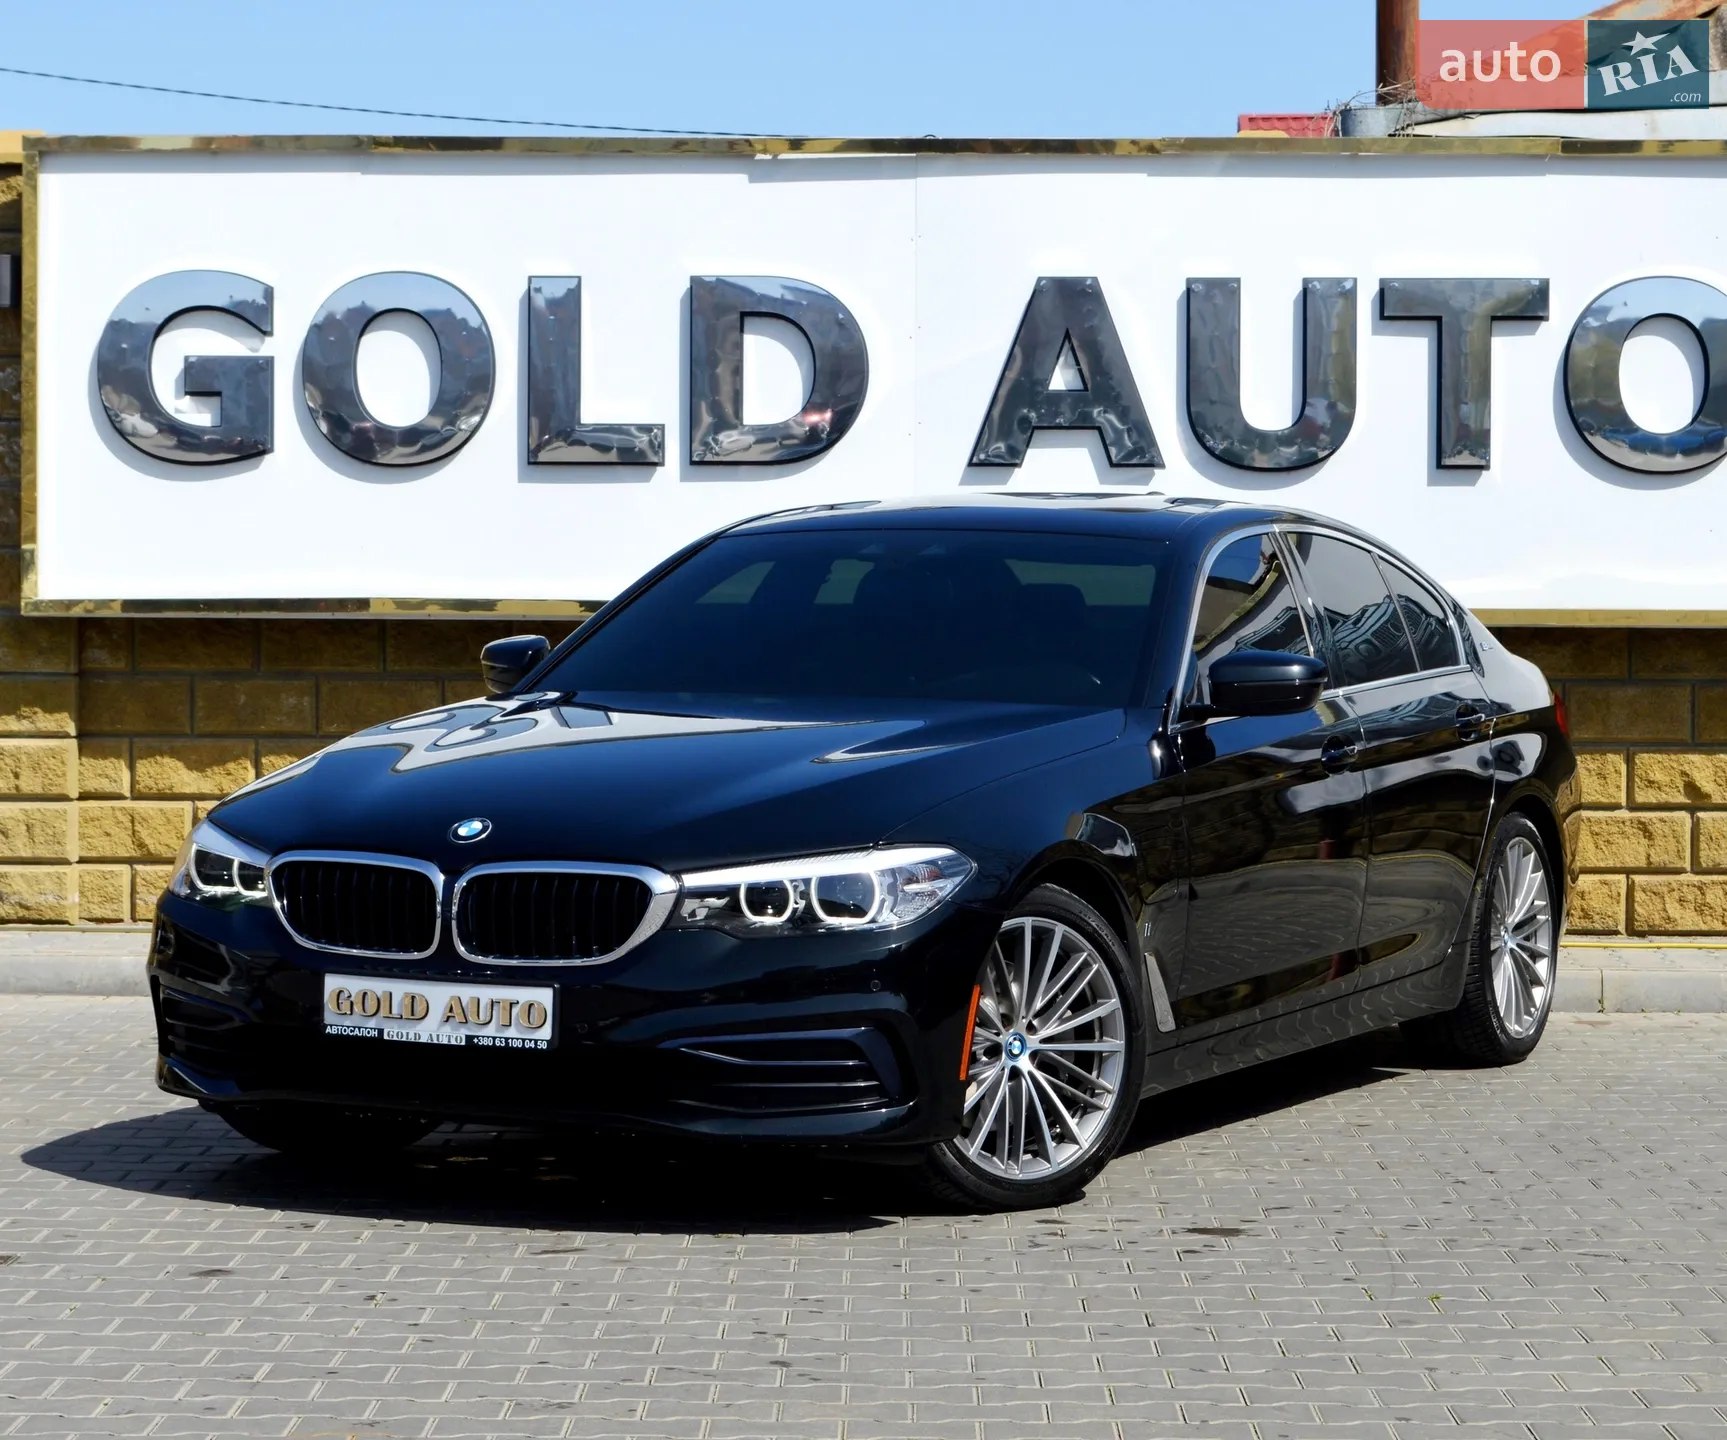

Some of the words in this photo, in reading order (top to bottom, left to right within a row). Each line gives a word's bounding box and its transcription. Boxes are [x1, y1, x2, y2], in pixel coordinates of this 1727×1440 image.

[97, 269, 869, 466] GOLD
[967, 276, 1727, 475] AUTO
[327, 987, 429, 1021] GOLD
[443, 995, 547, 1029] AUTO
[325, 1025, 378, 1038] АВТОСАЛОН
[386, 1030, 421, 1041] GOLD
[426, 1033, 463, 1044] AUTO
[473, 1037, 493, 1046] +380
[495, 1038, 505, 1047] 63
[508, 1039, 523, 1048] 100
[524, 1040, 535, 1049] 04
[537, 1040, 547, 1049] 50
